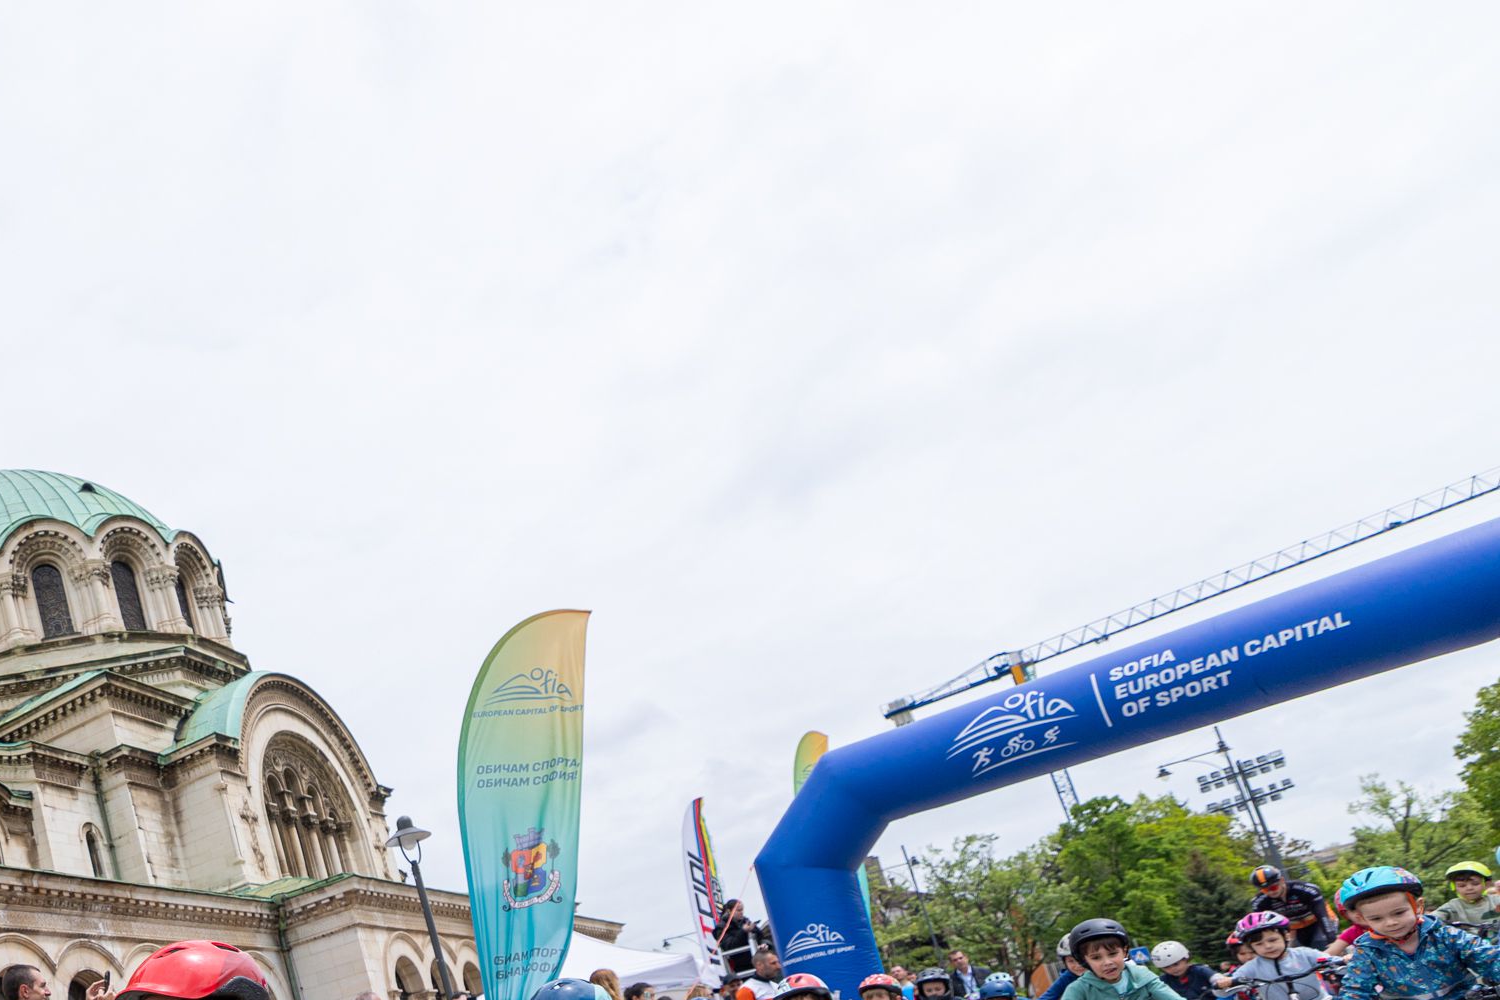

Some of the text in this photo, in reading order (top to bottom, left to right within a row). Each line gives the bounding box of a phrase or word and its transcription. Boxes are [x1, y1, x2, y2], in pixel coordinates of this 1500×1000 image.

[1108, 649, 1176, 681] SOFIA
[1114, 611, 1351, 701] EUROPEAN CAPITAL
[1122, 670, 1232, 719] OF SPORT
[473, 704, 584, 718] EUROPEAN CAPITAL OF SPORT
[476, 756, 581, 775] ОБИЧАМ СПОРТА,
[477, 770, 579, 789] ОБИЧАМ СОФИЯ!
